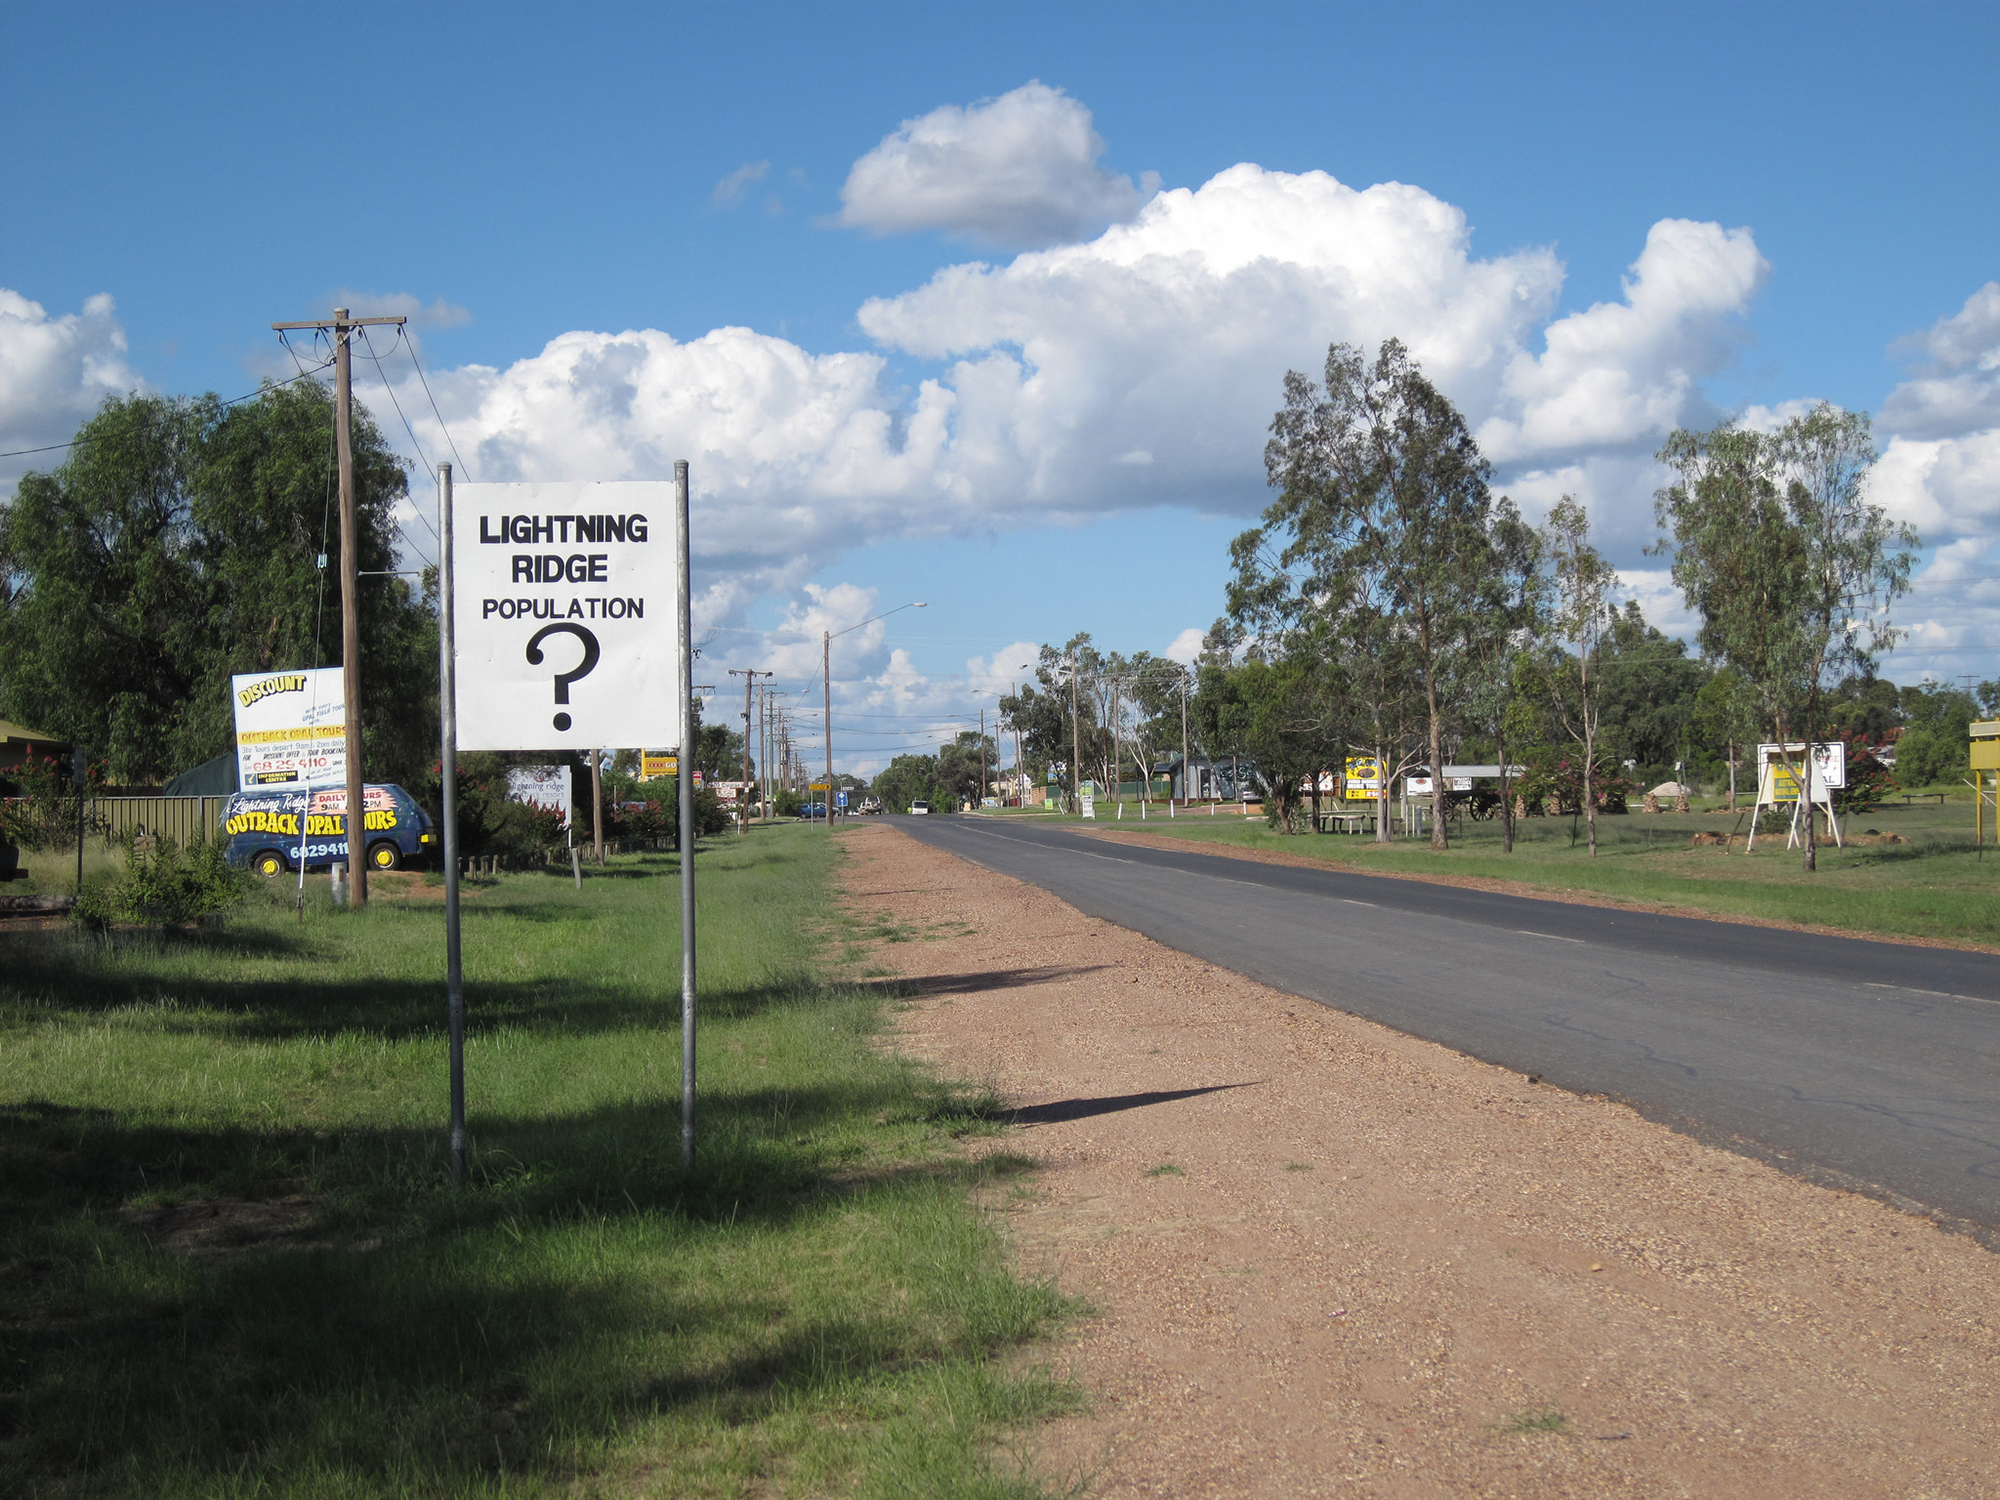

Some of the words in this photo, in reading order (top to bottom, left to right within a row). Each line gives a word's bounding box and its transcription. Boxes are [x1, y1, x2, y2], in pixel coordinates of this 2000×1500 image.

[479, 513, 648, 544] LIGHTNING
[512, 553, 608, 583] RIDGE
[482, 598, 644, 619] POPULATION
[526, 622, 600, 732] ?
[237, 675, 307, 707] DISCOUNT
[241, 730, 287, 743] OUTBACK
[290, 727, 313, 739] OPAL
[316, 726, 346, 737] TOURS
[253, 761, 272, 772] 68
[276, 759, 295, 770] 29
[299, 757, 327, 768] 4110
[258, 771, 296, 779] INFORMATION
[546, 780, 564, 792] ridge
[231, 797, 280, 815] Lightning
[319, 794, 346, 802] DAILY
[321, 803, 340, 811] 9AM
[225, 811, 299, 835] OUTBACK
[306, 815, 345, 835] OPAL
[290, 842, 350, 859] 6829411
